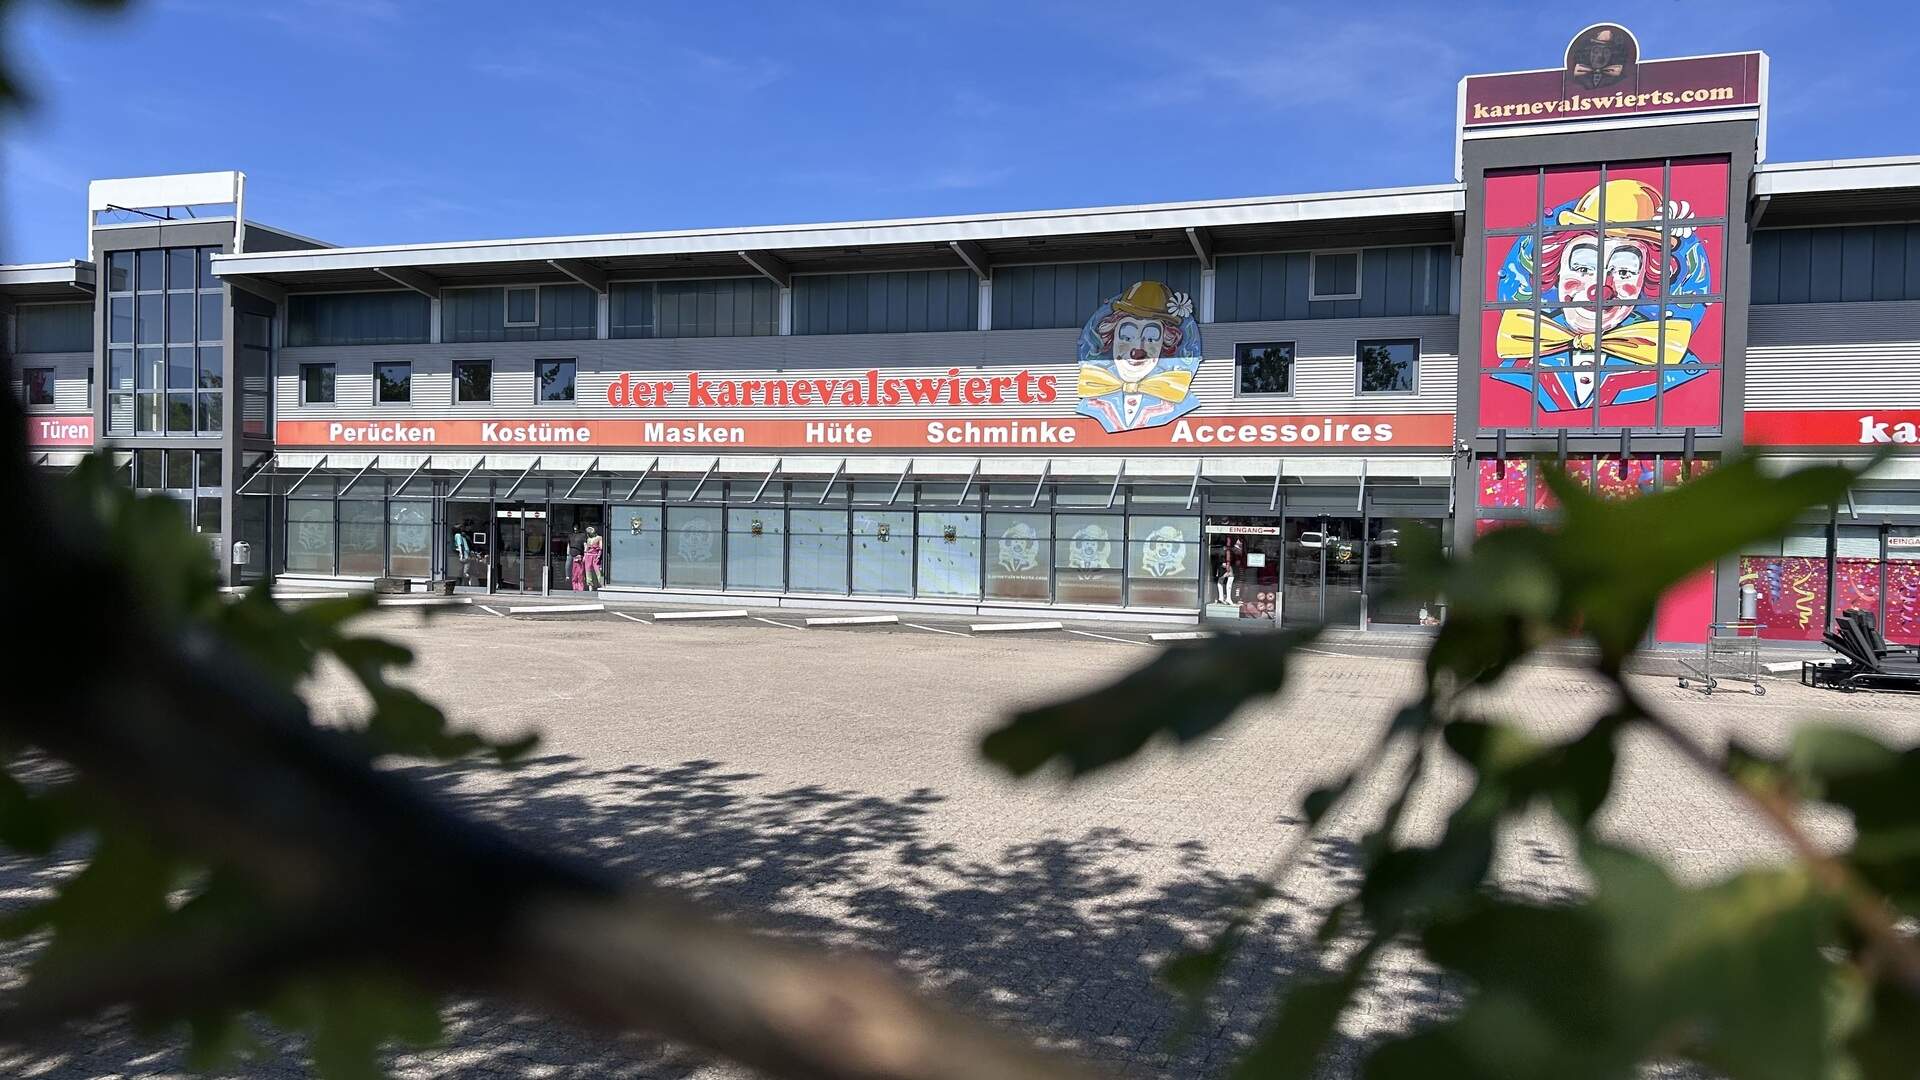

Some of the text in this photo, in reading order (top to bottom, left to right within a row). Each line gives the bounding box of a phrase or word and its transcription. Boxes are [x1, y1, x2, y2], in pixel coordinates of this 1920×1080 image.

[1473, 86, 1734, 119] karnevalswierts.com
[607, 368, 1057, 407] der karnevalswierts
[40, 420, 89, 439] Türen
[329, 419, 1393, 443] Perücken Kostüme Masken Hüte Schminke Accessoires
